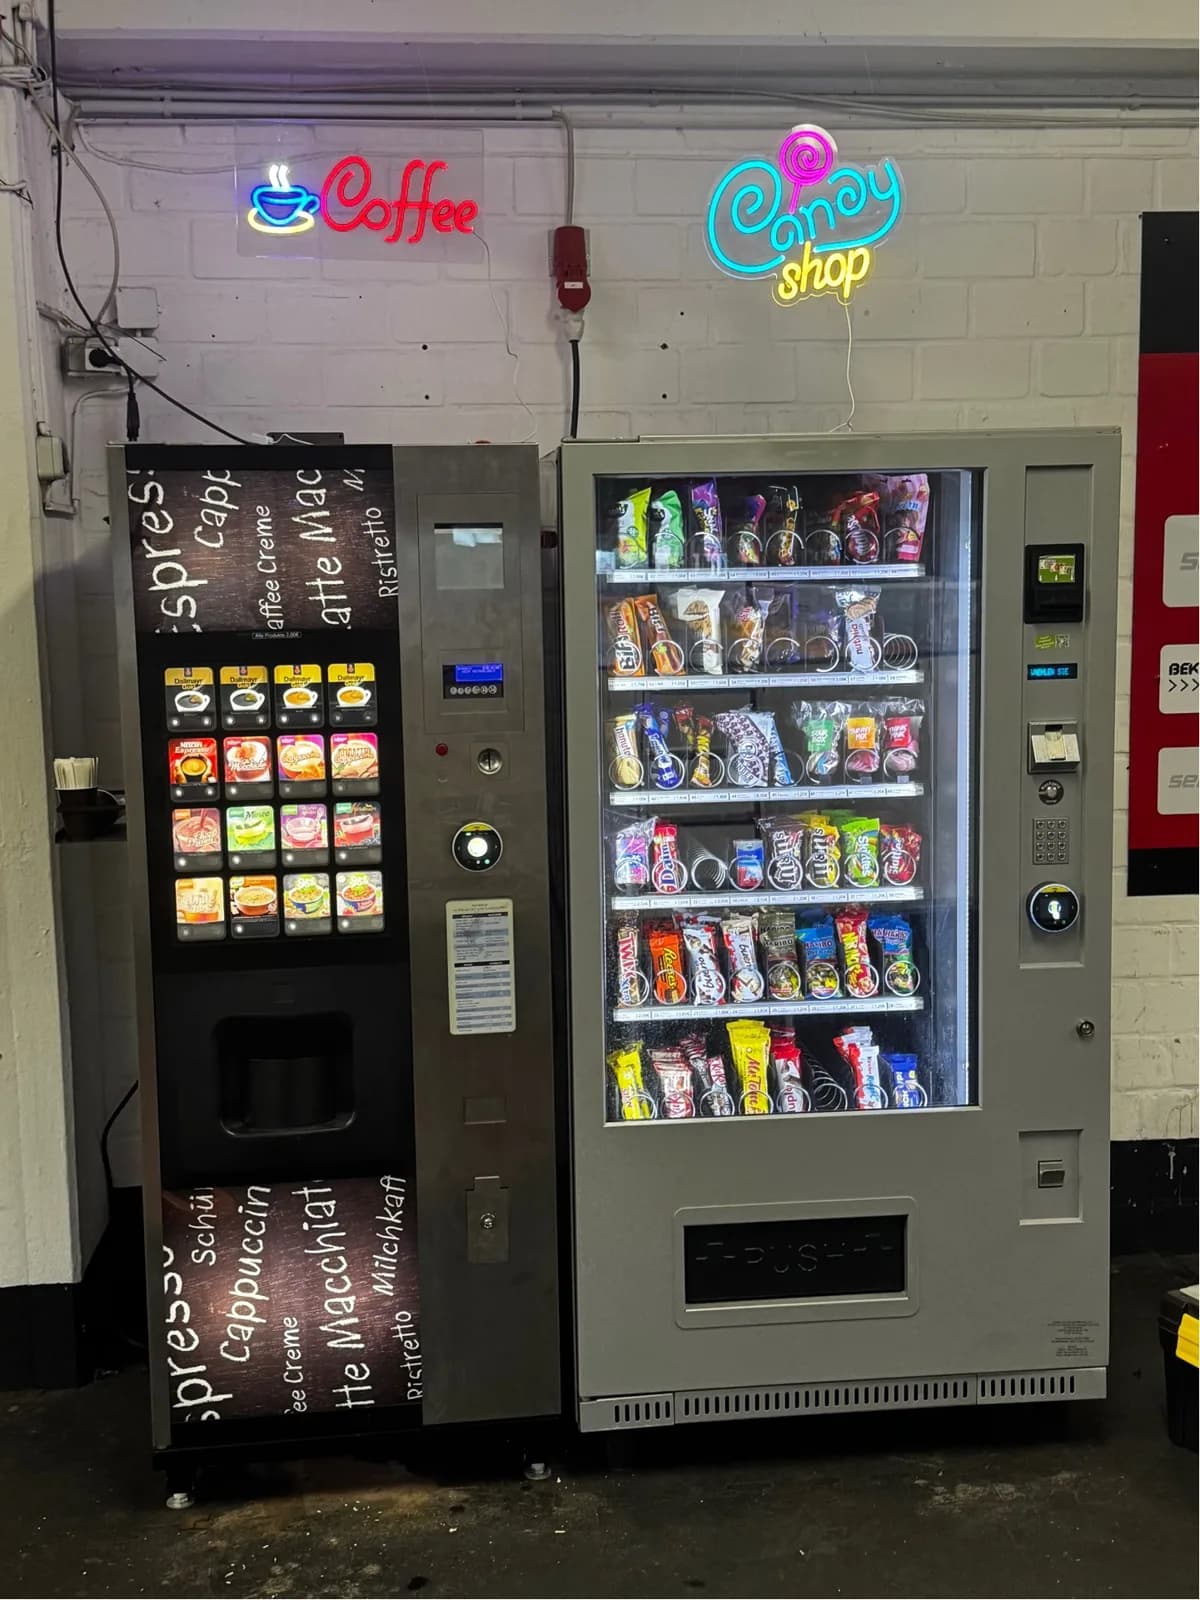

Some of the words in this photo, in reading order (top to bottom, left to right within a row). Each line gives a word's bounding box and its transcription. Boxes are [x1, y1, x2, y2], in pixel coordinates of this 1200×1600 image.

[319, 155, 480, 245] Coffee
[706, 157, 903, 275] Candy
[776, 240, 872, 301] shop
[255, 504, 279, 575] Creme
[290, 469, 339, 544] Mac
[127, 468, 209, 634] spres
[360, 506, 400, 600] Ristretto
[304, 555, 353, 631] atte
[659, 841, 676, 886] Daim
[698, 956, 715, 989] bueno
[188, 1186, 218, 1267] Schü
[290, 1180, 366, 1351] Macchiat
[282, 1315, 303, 1385] Creme
[389, 1309, 424, 1401] Ristretto
[284, 1389, 308, 1415] ee
